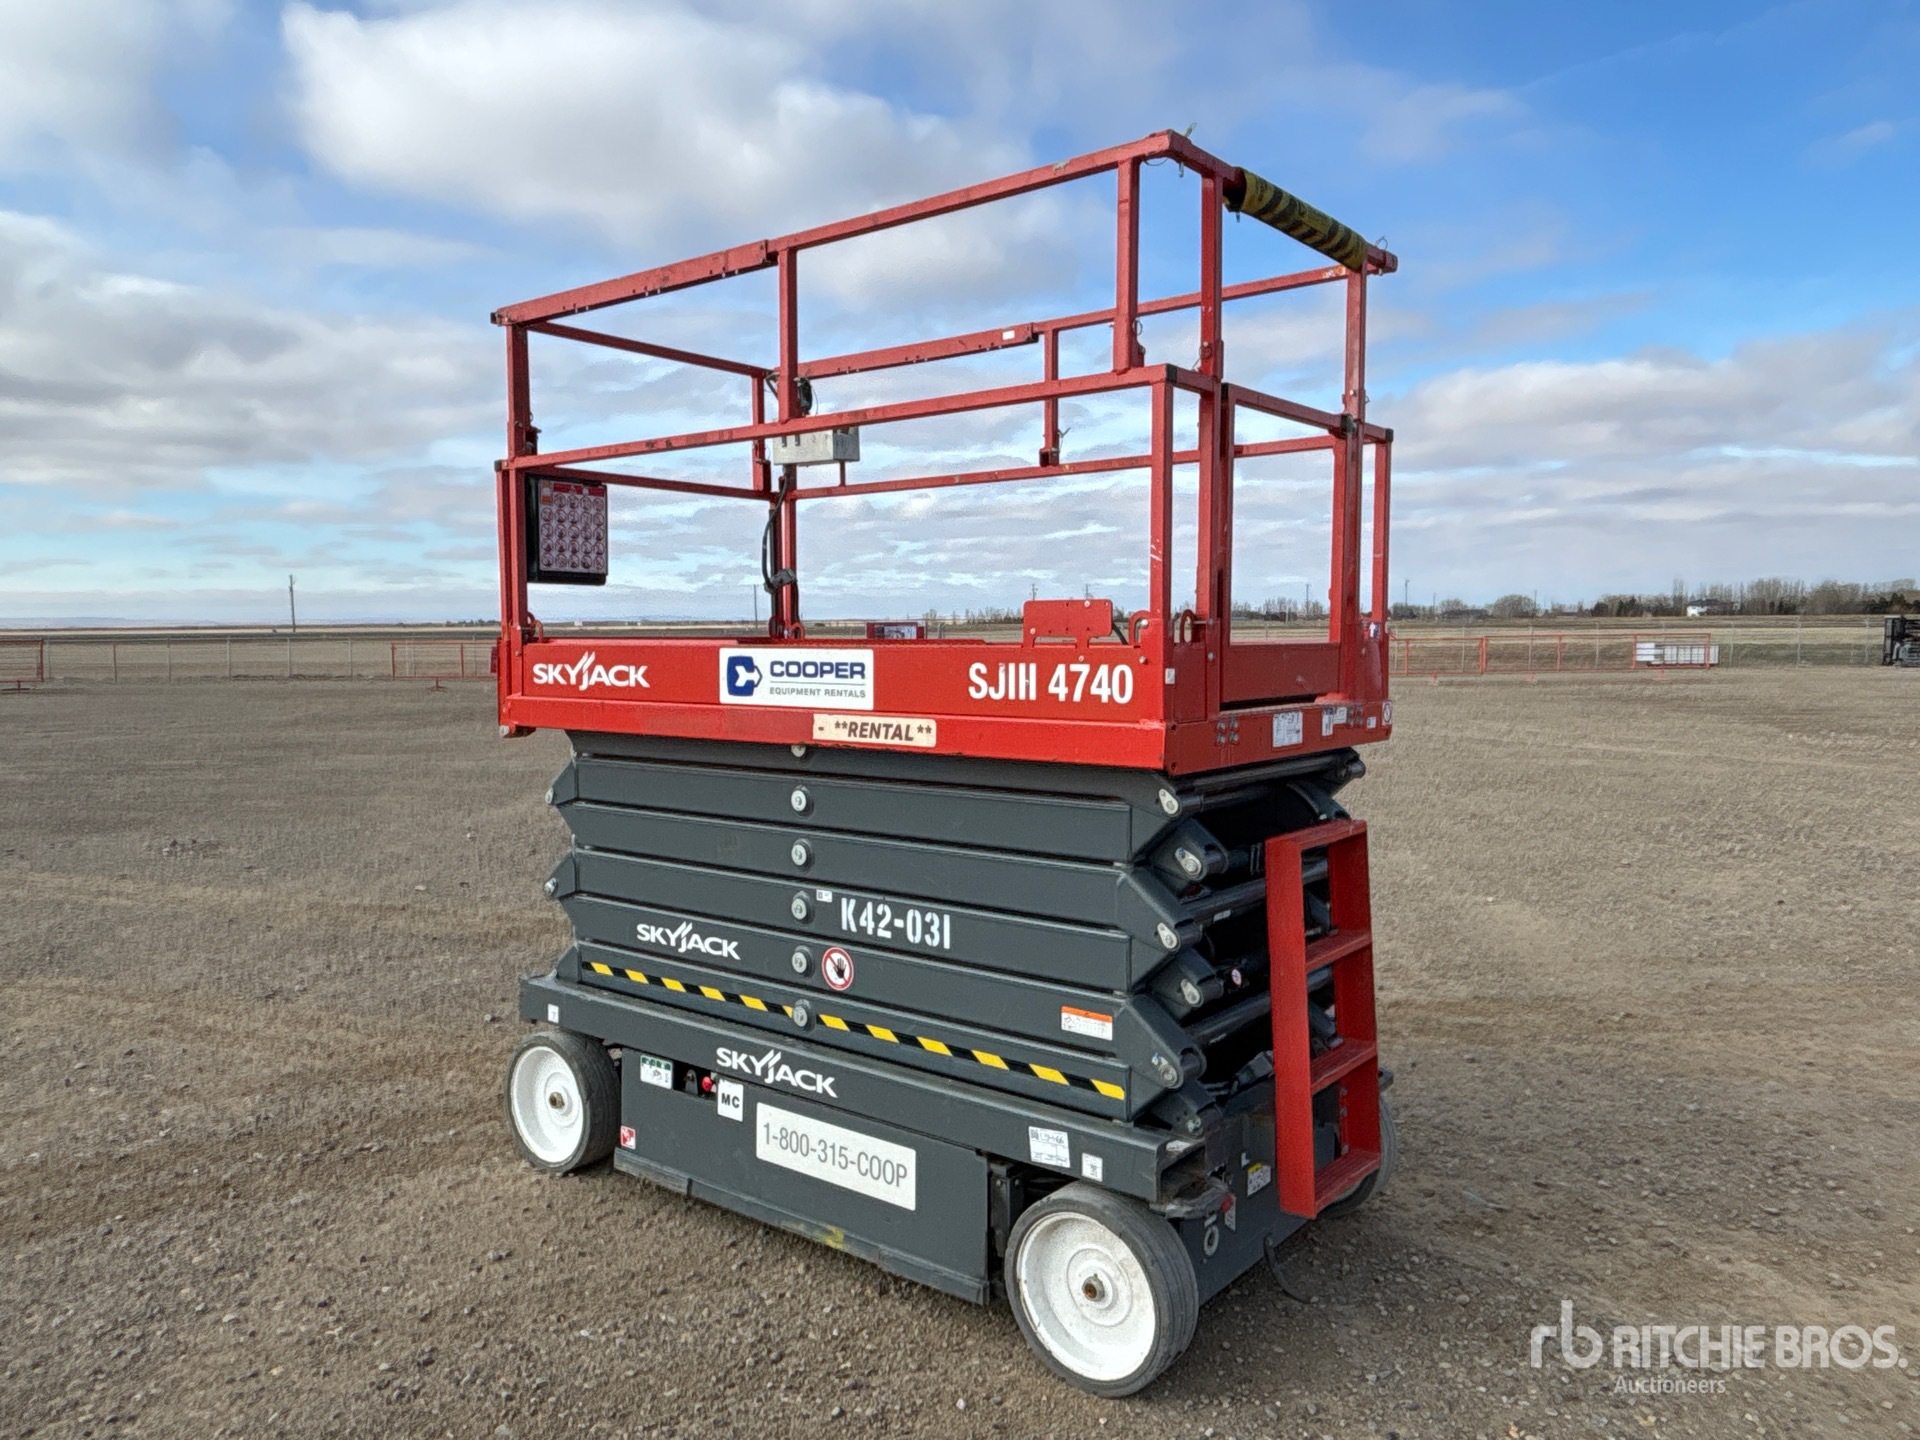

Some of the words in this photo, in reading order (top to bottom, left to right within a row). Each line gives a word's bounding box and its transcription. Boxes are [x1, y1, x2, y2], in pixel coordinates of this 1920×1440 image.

[533, 651, 650, 691] SKYJACK
[769, 660, 866, 680] COOPER
[1047, 663, 1133, 704] 4740
[769, 686, 821, 697] EQUIPMENT
[824, 688, 866, 698] RENTALS
[636, 920, 741, 960] SKYJACK
[716, 1047, 838, 1098] SKYJACK
[721, 1092, 740, 1109] MC
[763, 1122, 908, 1188] 1-800-315-COOP
